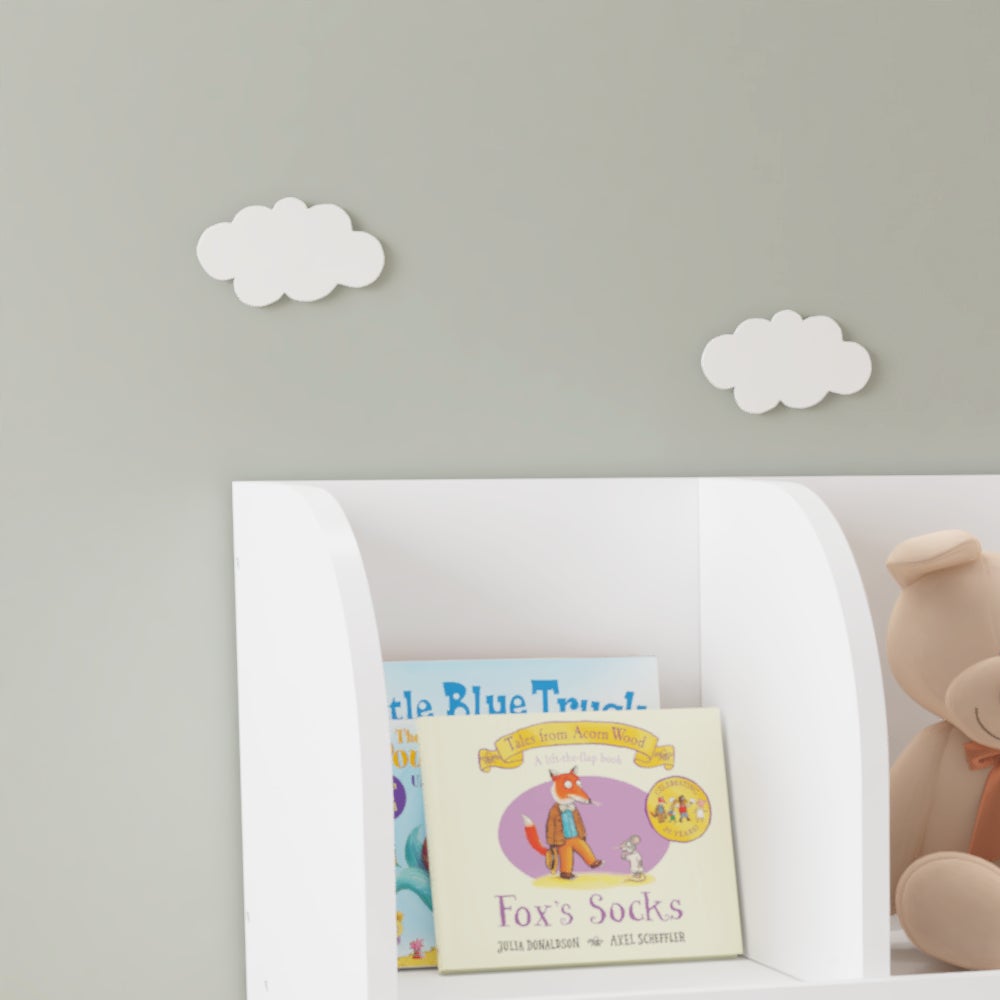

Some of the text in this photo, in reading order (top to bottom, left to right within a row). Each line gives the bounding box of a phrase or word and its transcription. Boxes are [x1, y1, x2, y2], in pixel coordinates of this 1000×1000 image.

[389, 689, 433, 720] tle
[443, 681, 527, 716] Blue
[395, 728, 418, 744] Th
[504, 725, 647, 751] Tales from Acorn Wood
[494, 890, 684, 927] Fox's Socks
[497, 930, 686, 953] JULIA DONALDSON AXEL SCHEFFLER
